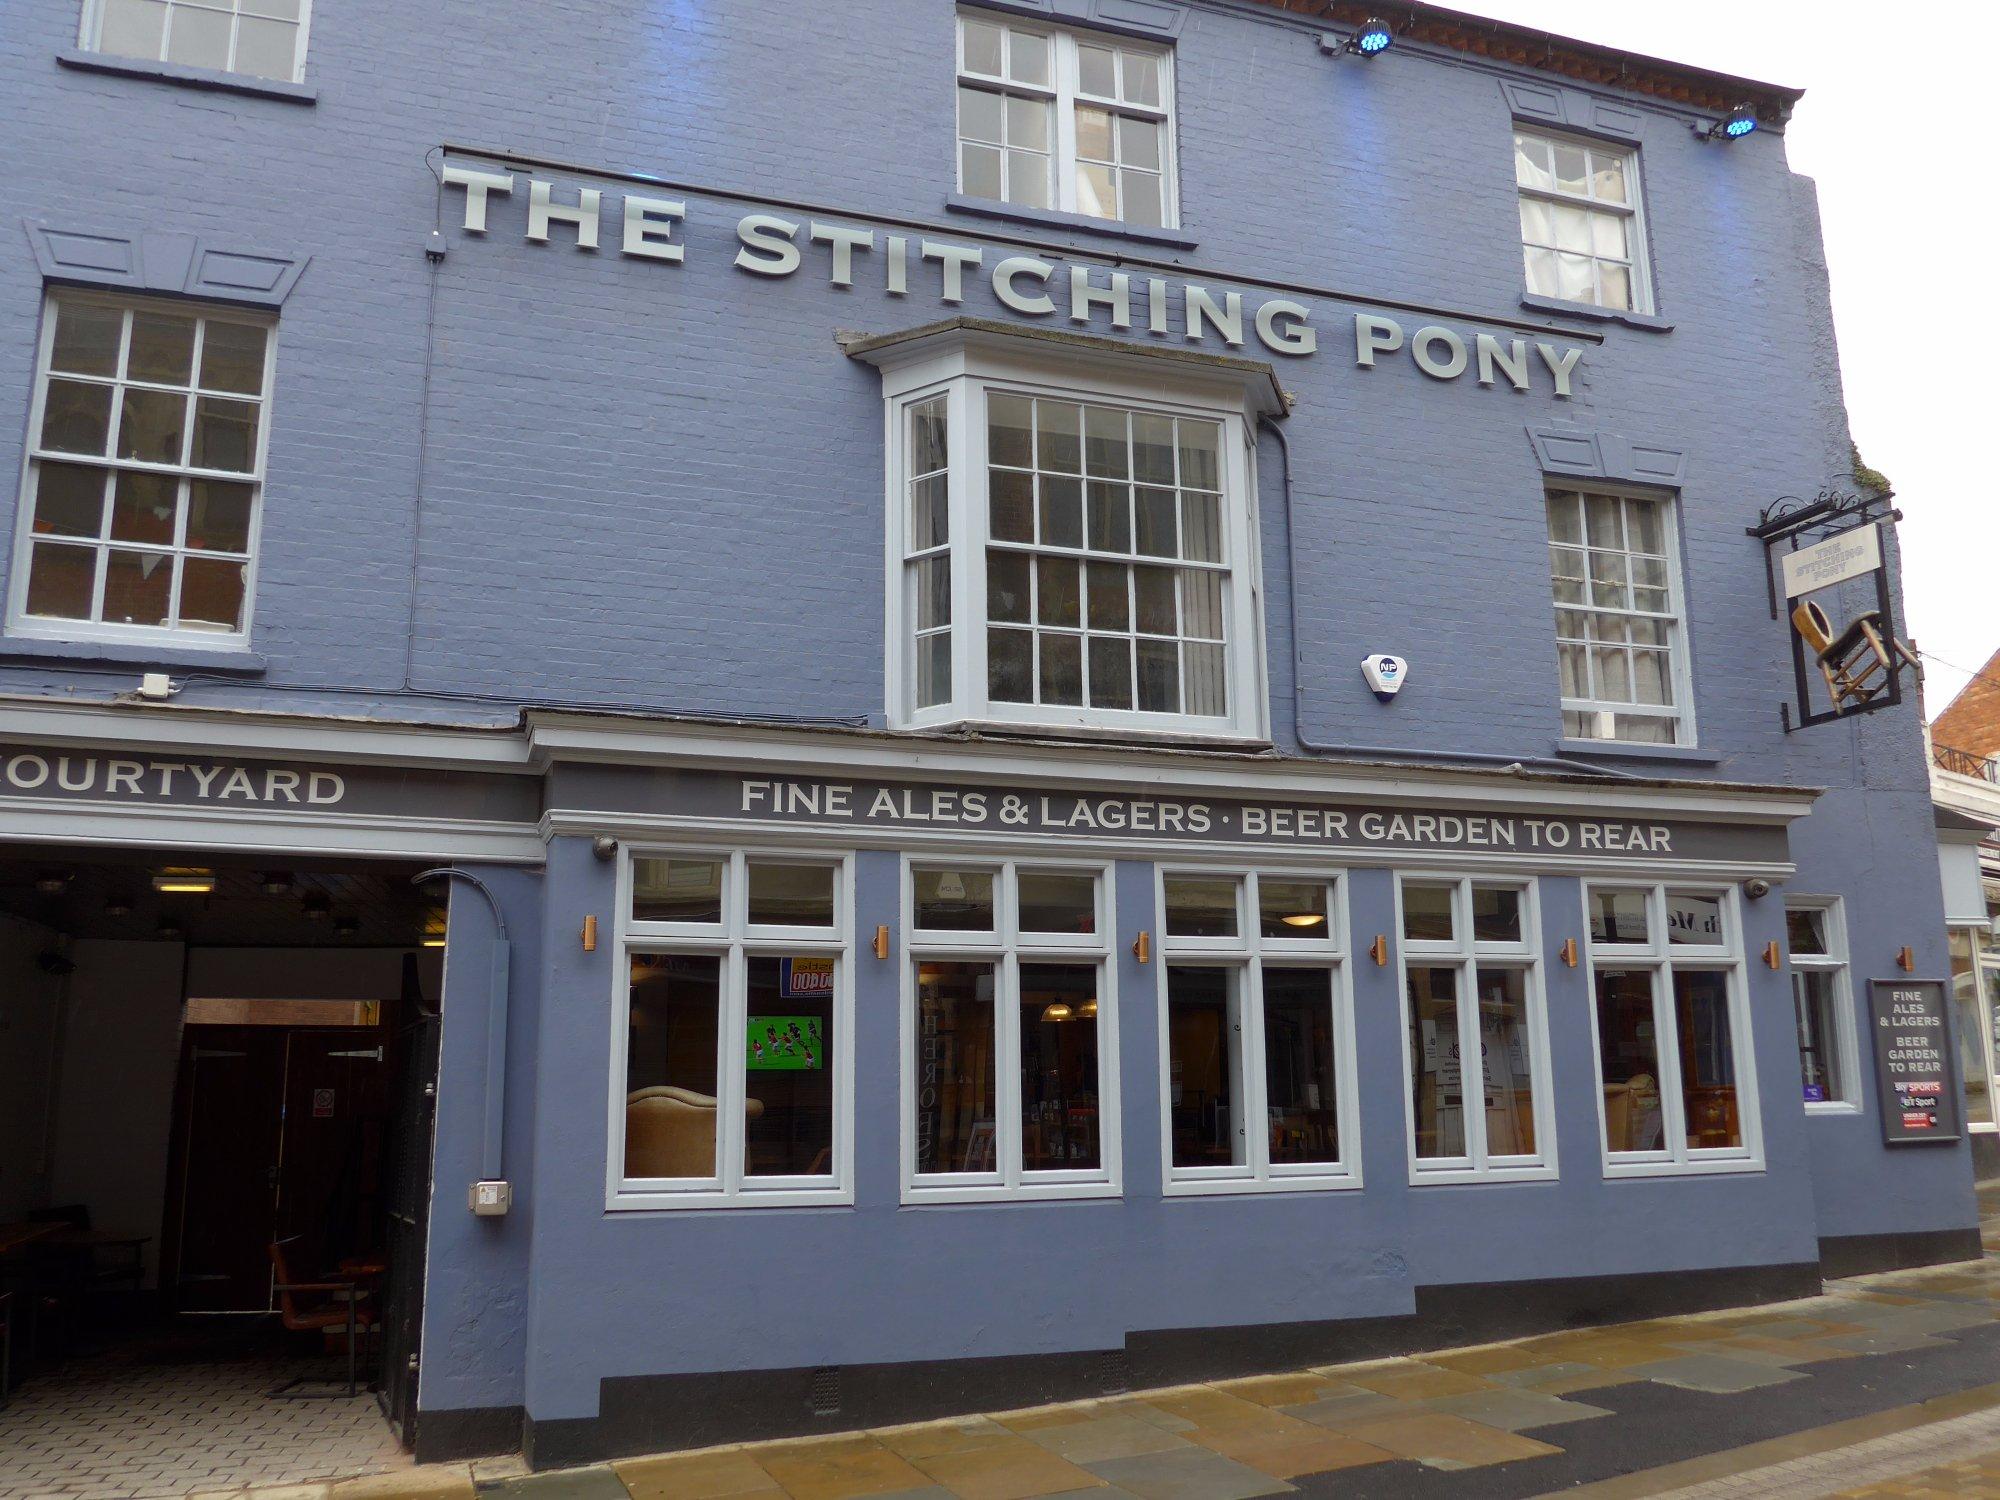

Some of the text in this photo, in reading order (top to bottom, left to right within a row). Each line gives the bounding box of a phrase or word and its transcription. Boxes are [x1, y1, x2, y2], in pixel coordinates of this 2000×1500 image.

[442, 164, 1586, 397] THE STITCHING PONY
[1815, 542, 1841, 559] THE
[1796, 545, 1865, 577] STITCHING
[0, 754, 346, 804] OURTYARD
[740, 780, 1673, 852] FINE ALES & LAGERS BEER GARDEN TO REAR
[1892, 991, 1922, 1001] FINE
[1893, 1004, 1925, 1014] ALES
[1879, 1016, 1940, 1027] & LAGERS
[1896, 1036, 1929, 1047] BEER
[1888, 1049, 1938, 1060] GARDEN
[1888, 1062, 1941, 1073] TO REAR
[1909, 1081, 1941, 1092] SPORTS
[1915, 1097, 1936, 1108] Sport
